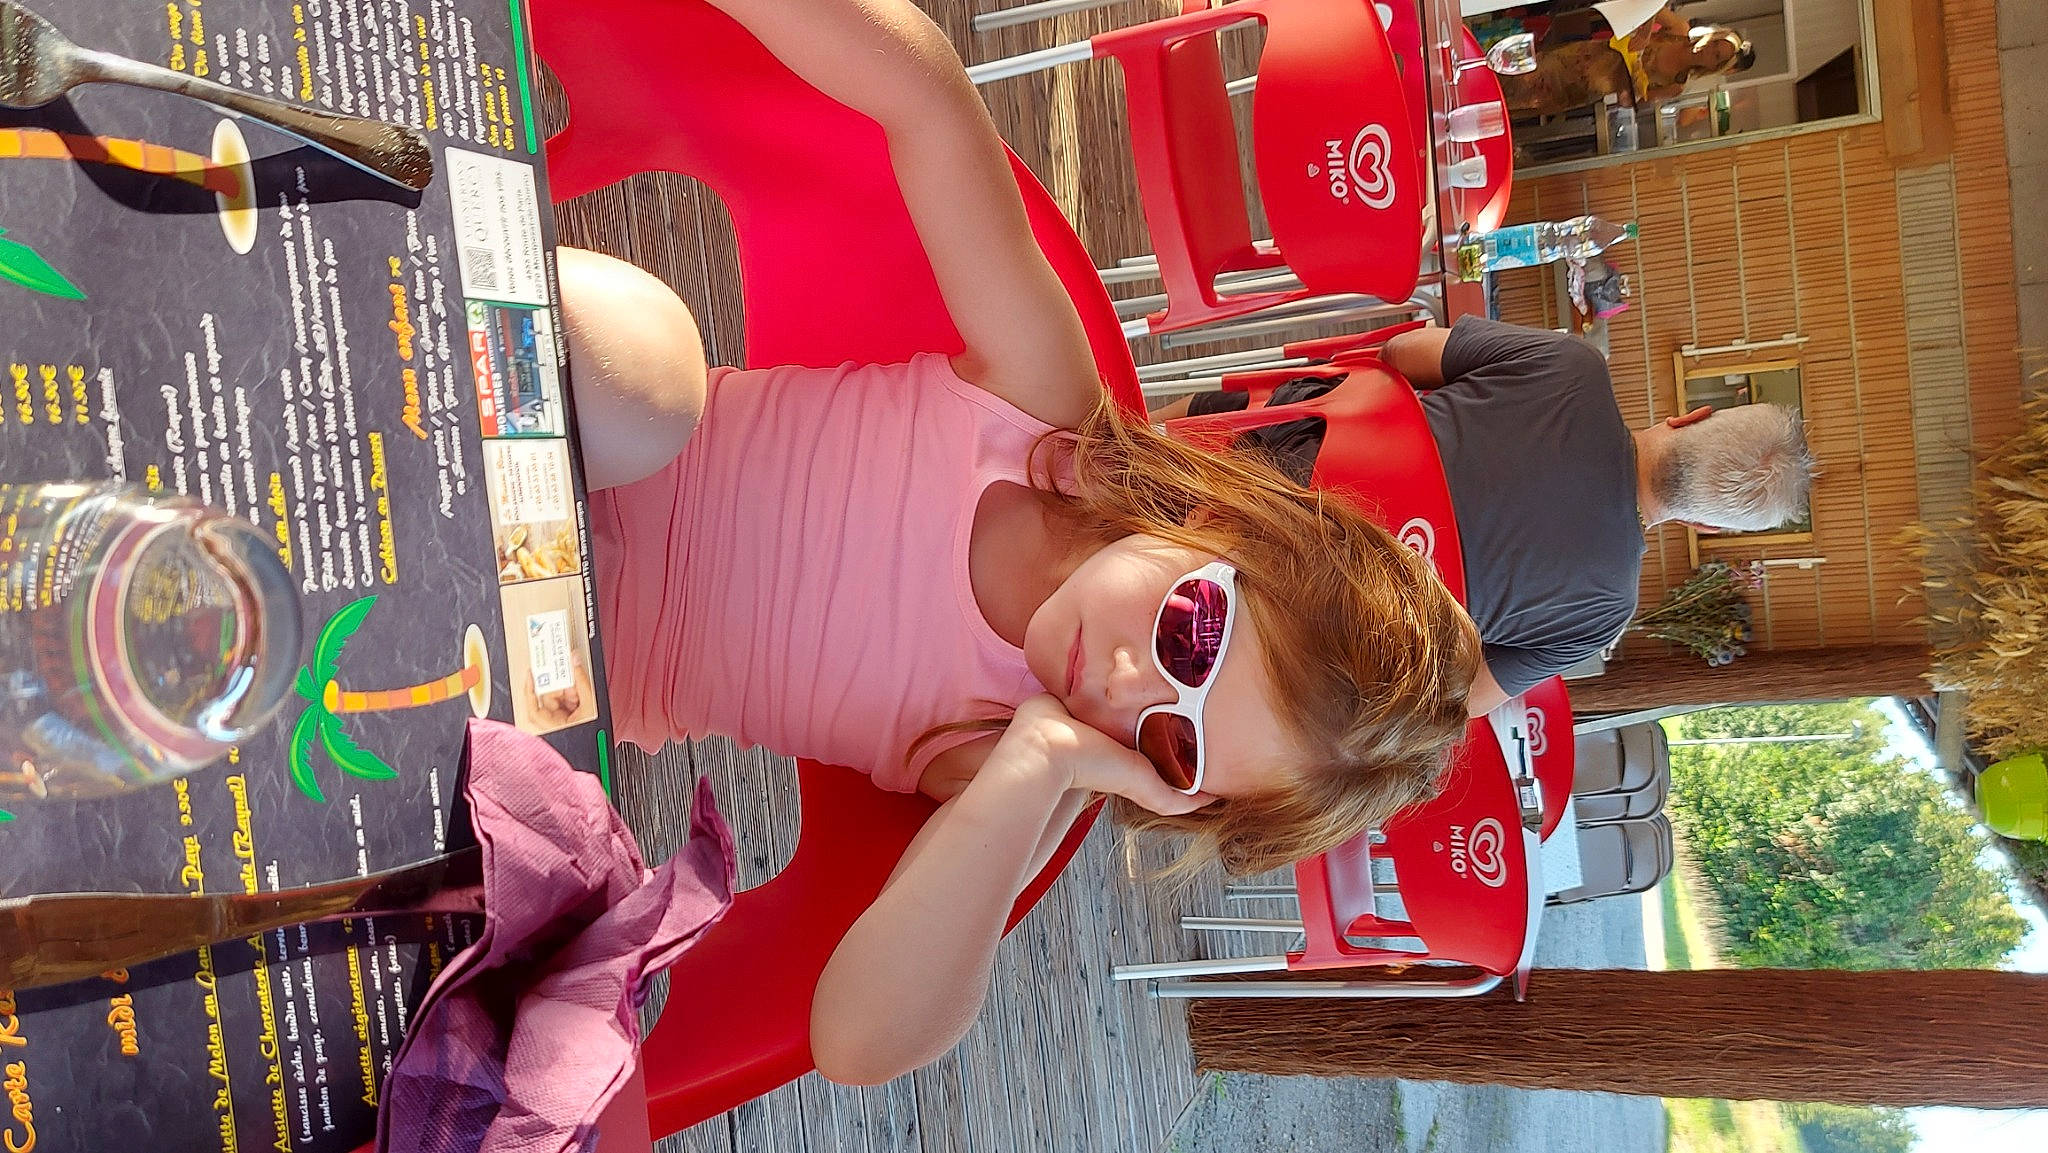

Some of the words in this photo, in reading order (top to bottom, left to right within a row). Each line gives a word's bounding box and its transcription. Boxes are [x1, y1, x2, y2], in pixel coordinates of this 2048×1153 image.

[1325, 140, 1348, 198] MIKO
[388, 284, 416, 361] enfant
[472, 332, 493, 417] SPAR
[402, 368, 428, 440] Menu
[368, 432, 387, 493] Dessert
[173, 778, 192, 826] 9.90€
[226, 774, 254, 857] (Raynal)
[181, 835, 204, 887] Pays
[1449, 826, 1466, 873] MIKO
[195, 945, 216, 990] Jam
[276, 927, 287, 961] terrin
[370, 951, 382, 991] melon,
[204, 994, 217, 1017] au
[253, 962, 279, 1059] Charcuterie
[300, 956, 318, 1024] cornichons,
[107, 994, 139, 1054] midi
[285, 1001, 299, 1041] boudin
[377, 995, 389, 1045] tomates,
[207, 1023, 229, 1080] Melon
[266, 1064, 280, 1084] de
[315, 1068, 326, 1084] de
[359, 1046, 378, 1106] Assiette
[3, 1061, 36, 1153] Carte
[213, 1088, 229, 1109] de
[272, 1088, 292, 1152] Assiette
[298, 1087, 313, 1142] (saucisse
[318, 1087, 335, 1131] jambon
